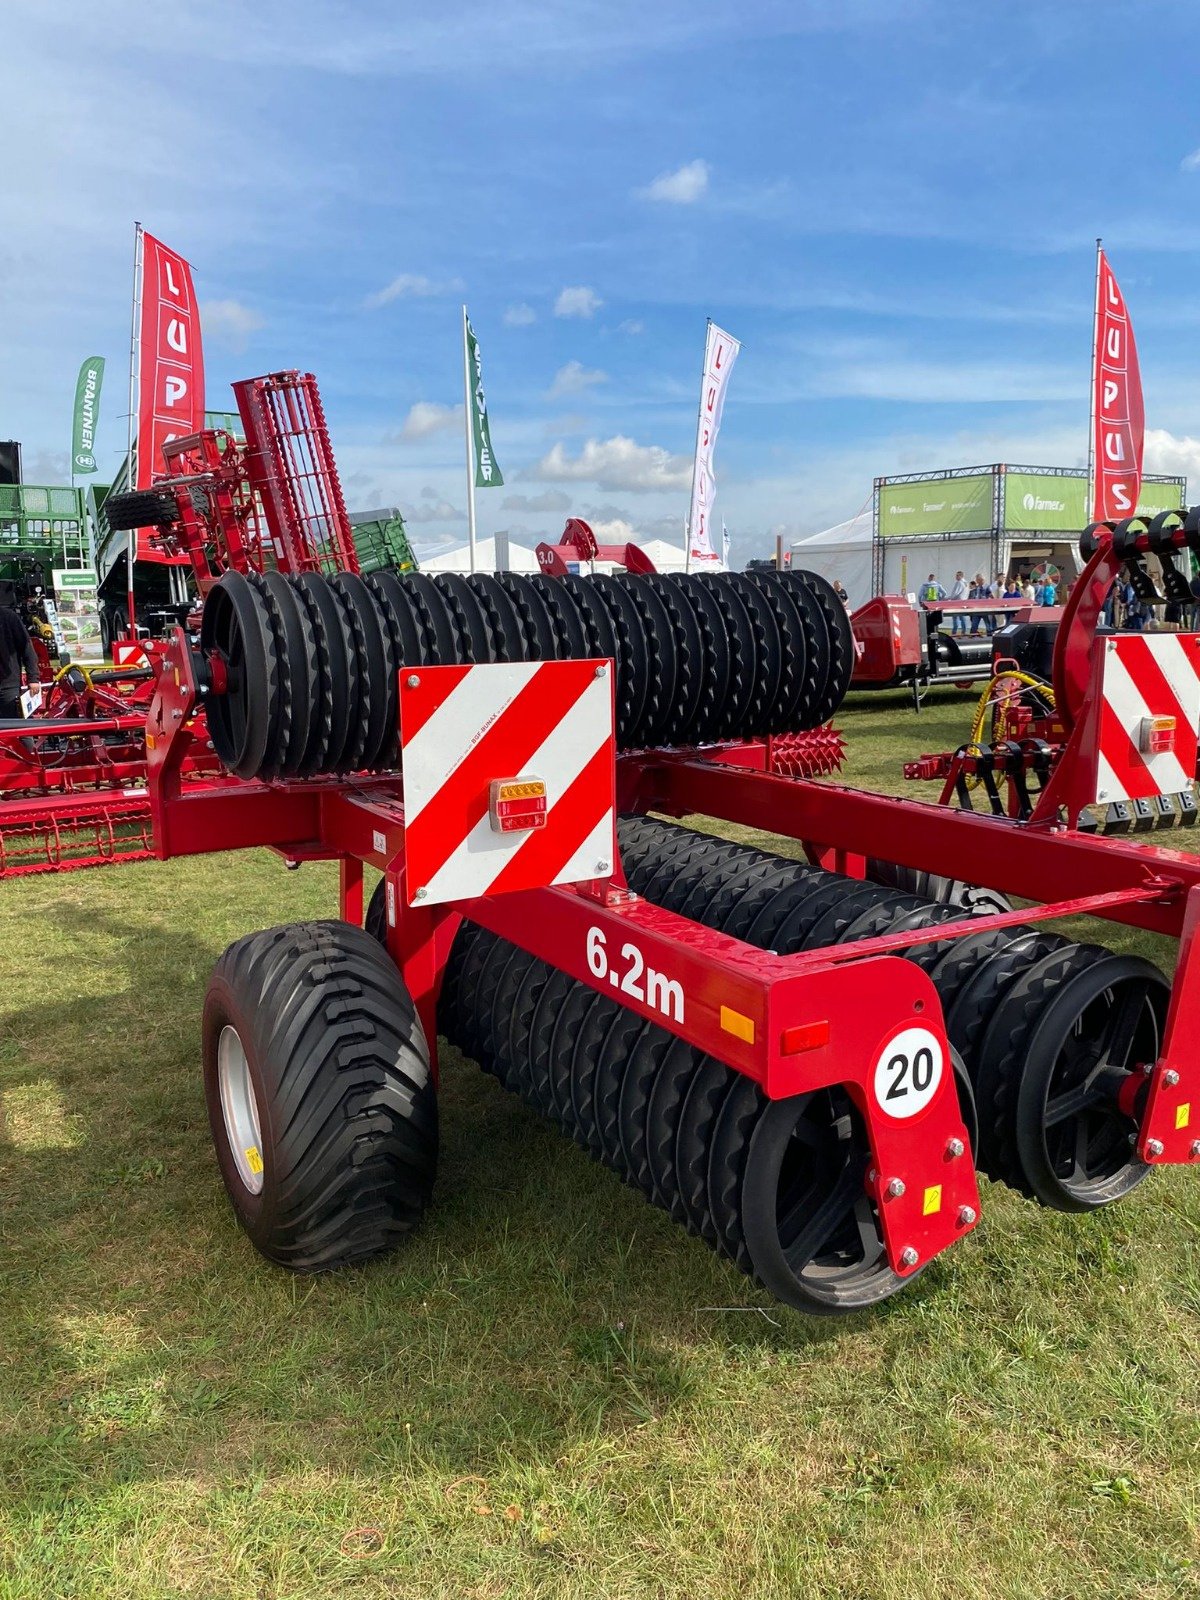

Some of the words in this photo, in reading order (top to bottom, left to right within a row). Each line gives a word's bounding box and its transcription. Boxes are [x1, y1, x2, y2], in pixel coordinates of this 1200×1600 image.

[81, 369, 97, 450] BRANTNER
[1104, 275, 1132, 511] LUPUS
[539, 550, 554, 564] 3.0
[585, 926, 685, 1025] 6.2m
[885, 1047, 934, 1100] 20
